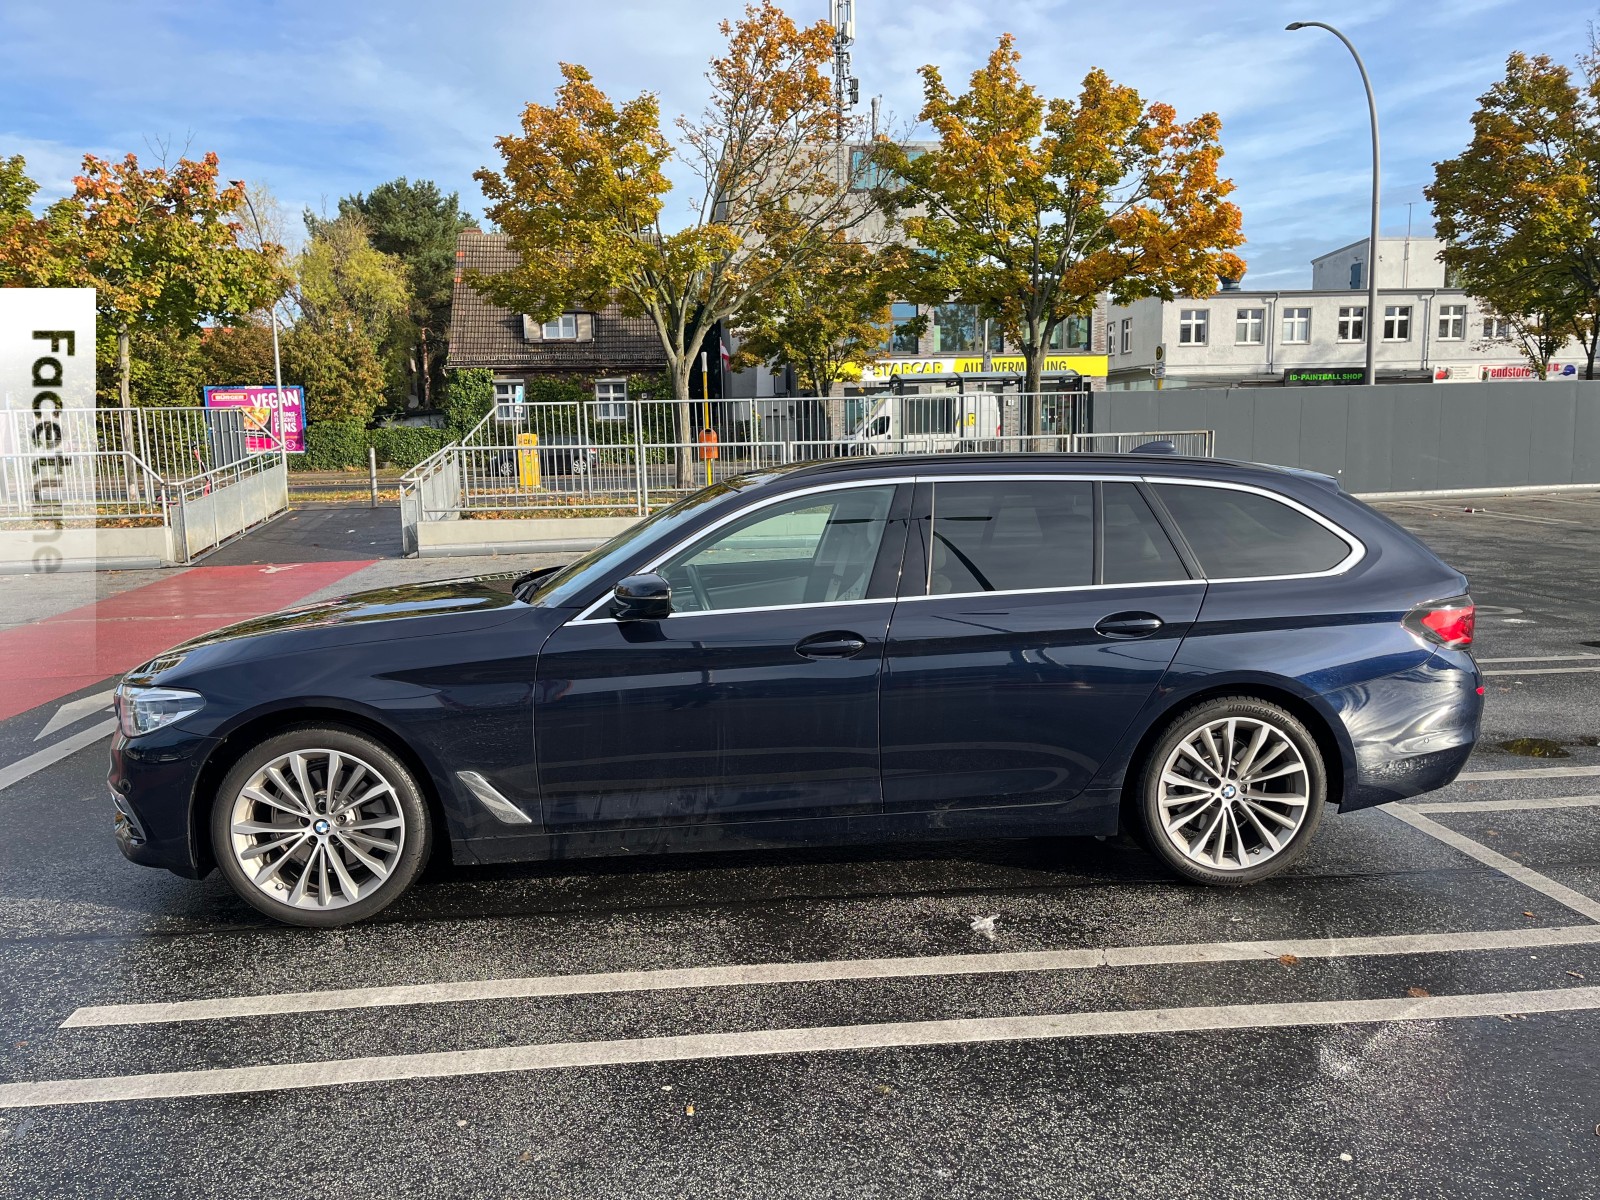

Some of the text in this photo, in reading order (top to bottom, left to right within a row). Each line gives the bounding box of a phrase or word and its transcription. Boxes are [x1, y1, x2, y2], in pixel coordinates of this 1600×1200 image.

[873, 362, 944, 377] STARCAR
[250, 390, 300, 409] VEGAN
[275, 422, 298, 433] FNS
[1227, 704, 1291, 726] BRIDGESTONE
